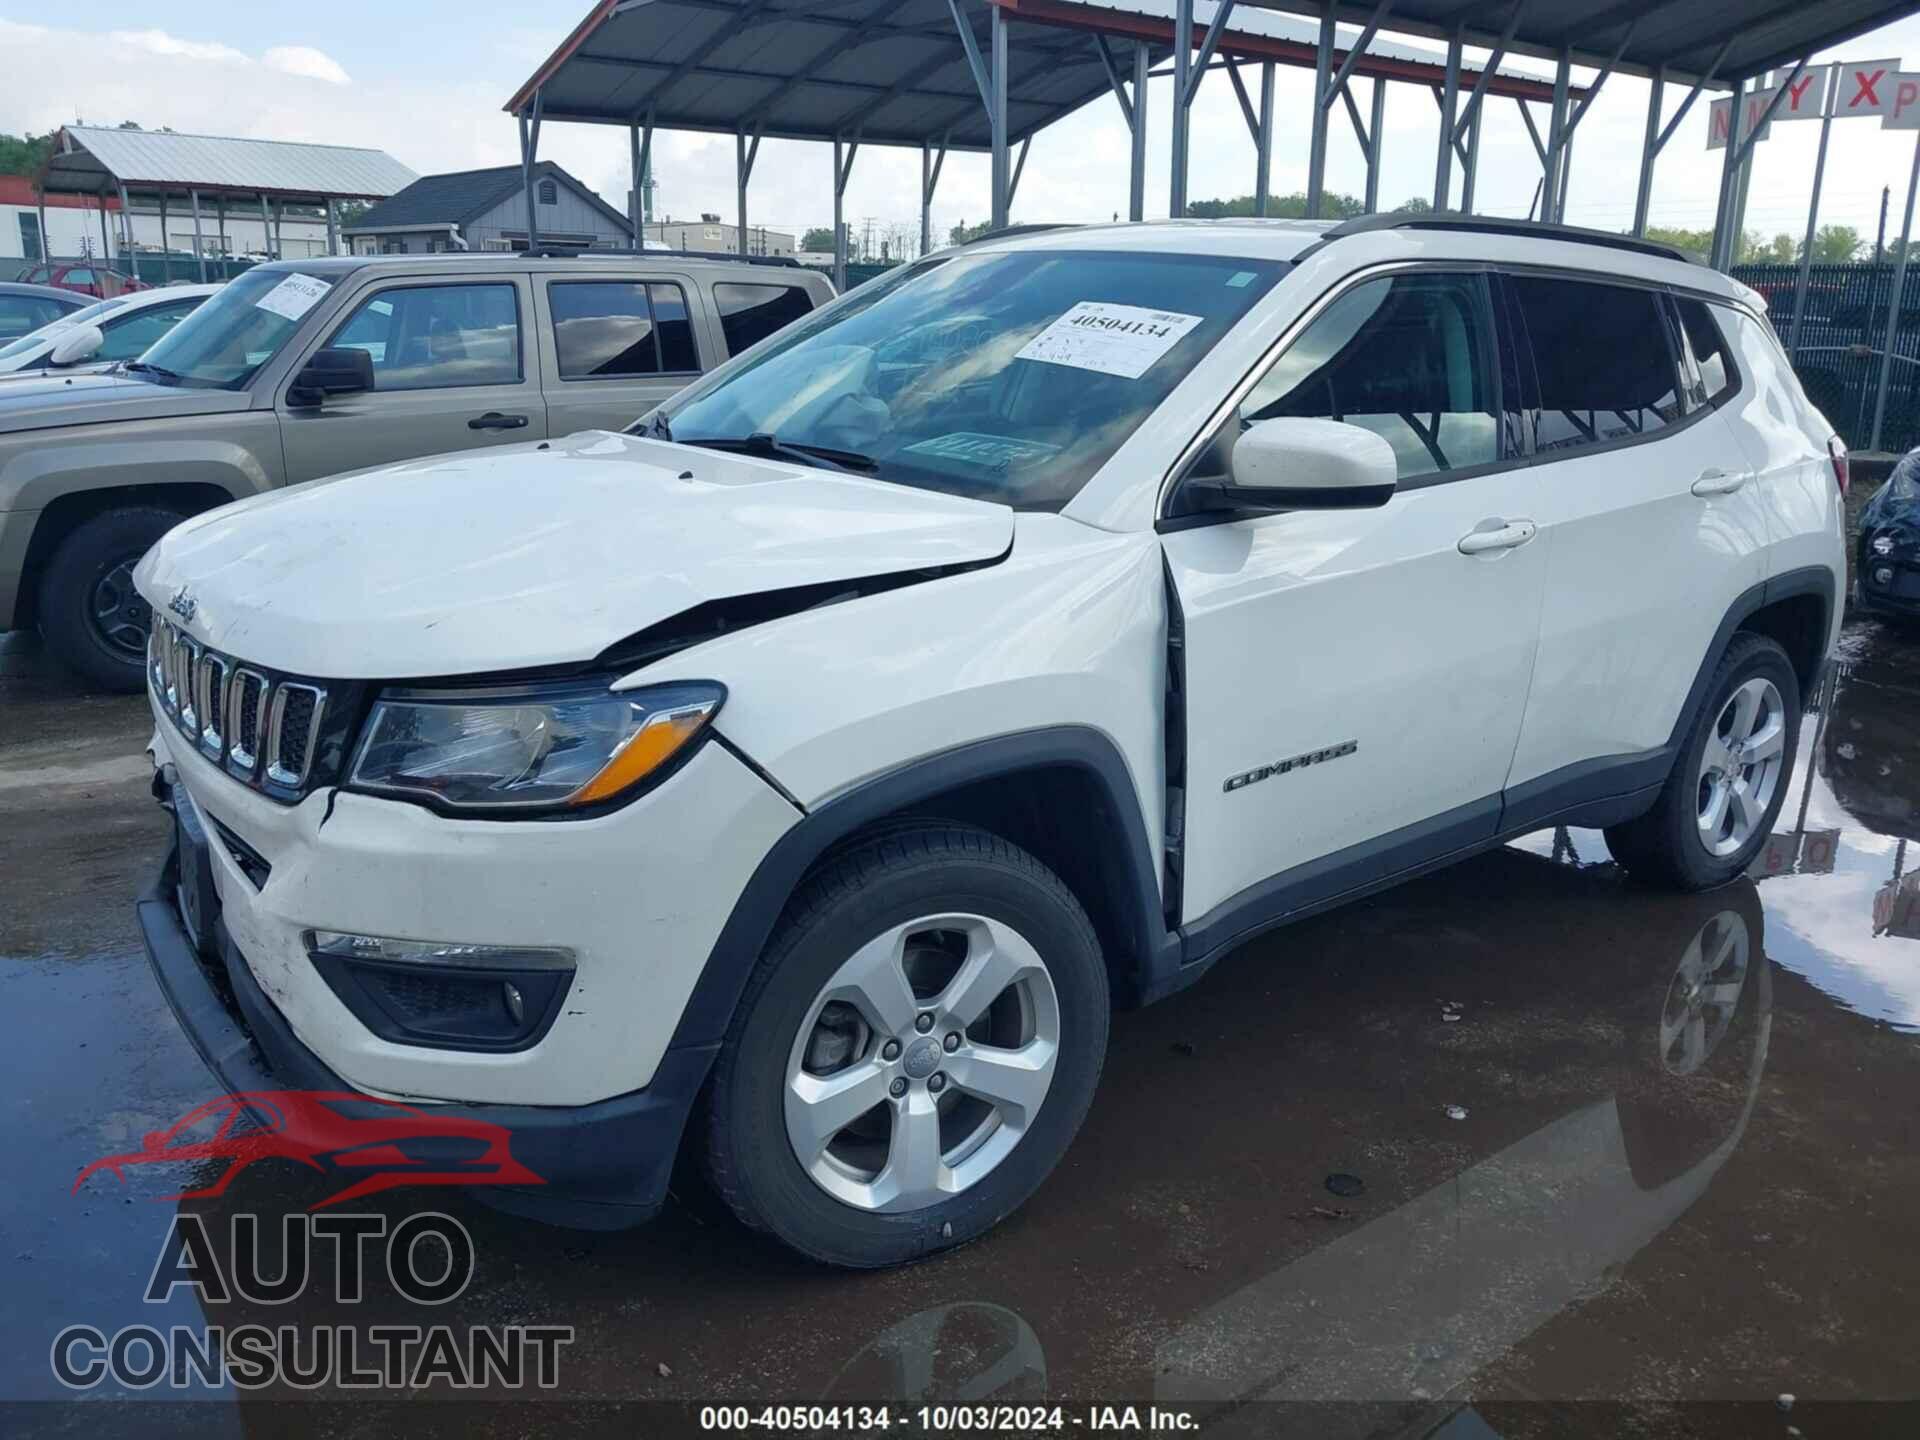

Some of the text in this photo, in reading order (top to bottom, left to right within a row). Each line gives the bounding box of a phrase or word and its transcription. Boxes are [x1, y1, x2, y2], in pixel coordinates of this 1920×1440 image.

[1784, 74, 1814, 111] Y
[1848, 69, 1887, 108] X
[1893, 80, 1919, 119] P
[1068, 314, 1171, 339] 40504134
[1223, 739, 1358, 793] COMPASS
